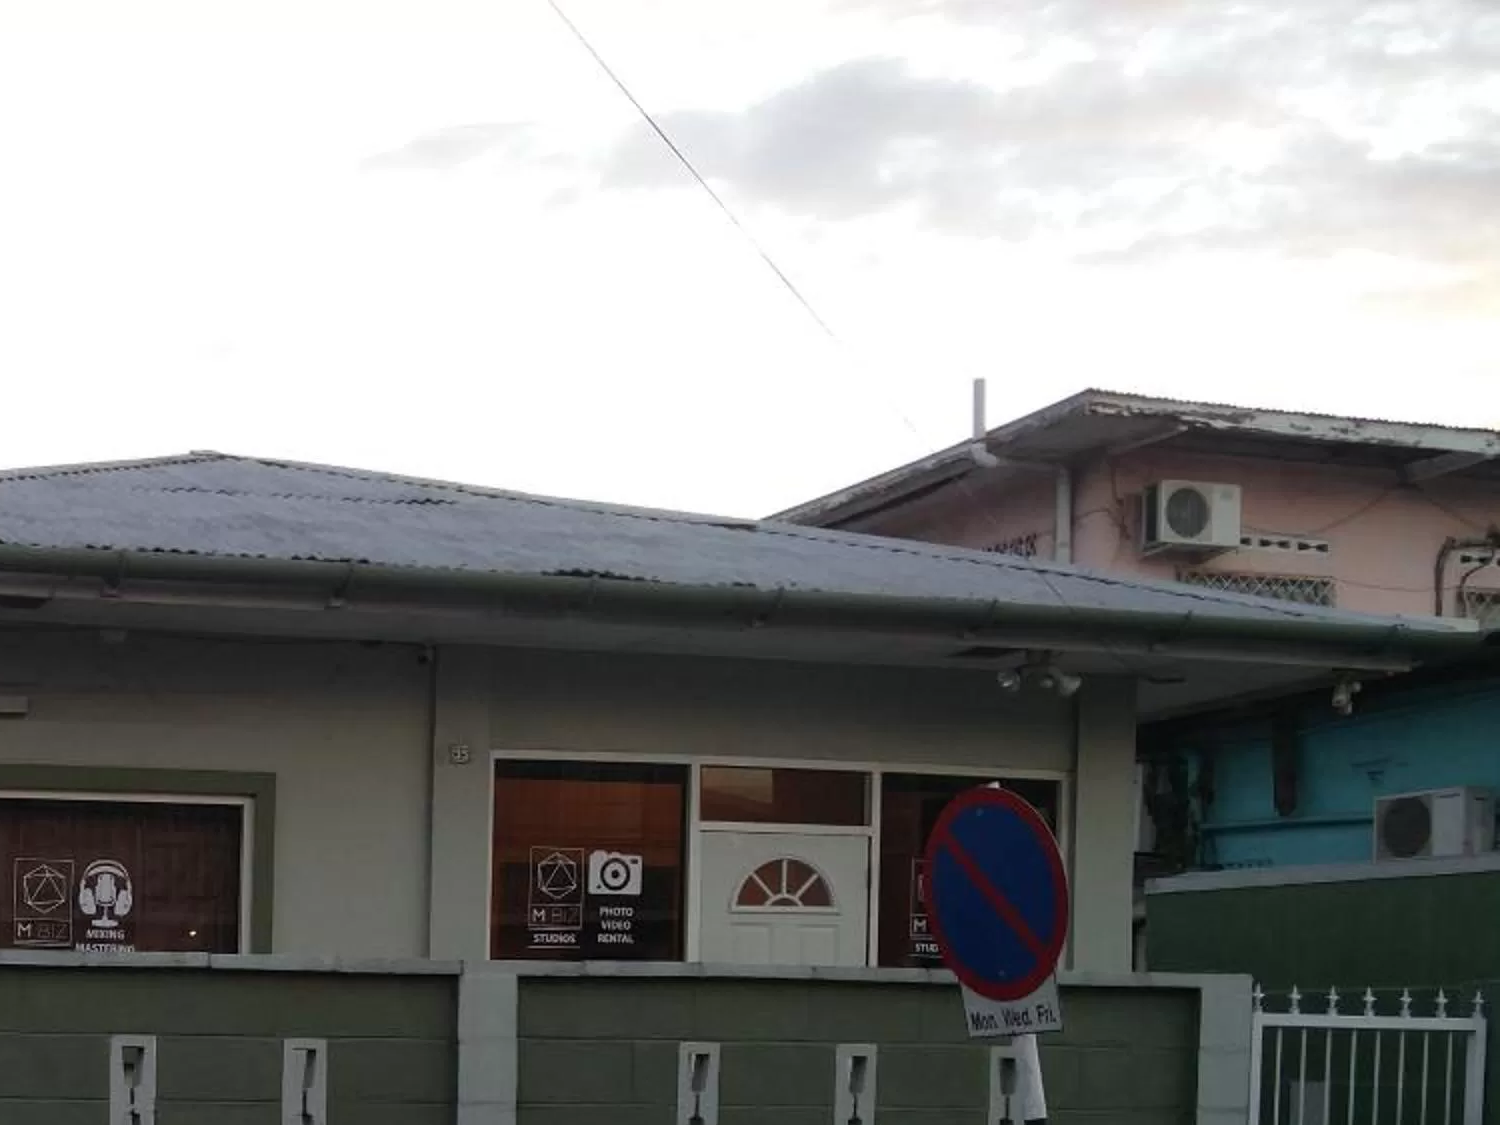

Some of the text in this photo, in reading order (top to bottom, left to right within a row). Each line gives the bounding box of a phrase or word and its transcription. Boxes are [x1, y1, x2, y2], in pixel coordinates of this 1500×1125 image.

[532, 907, 546, 922] M
[599, 906, 634, 917] PHOTO
[17, 922, 32, 938] M
[601, 920, 631, 931] VIDEO
[913, 919, 927, 932] M
[86, 928, 125, 940] MIXING
[532, 932, 578, 944] STUDIOS
[597, 933, 635, 944] RENTAL
[915, 943, 940, 953] STUD
